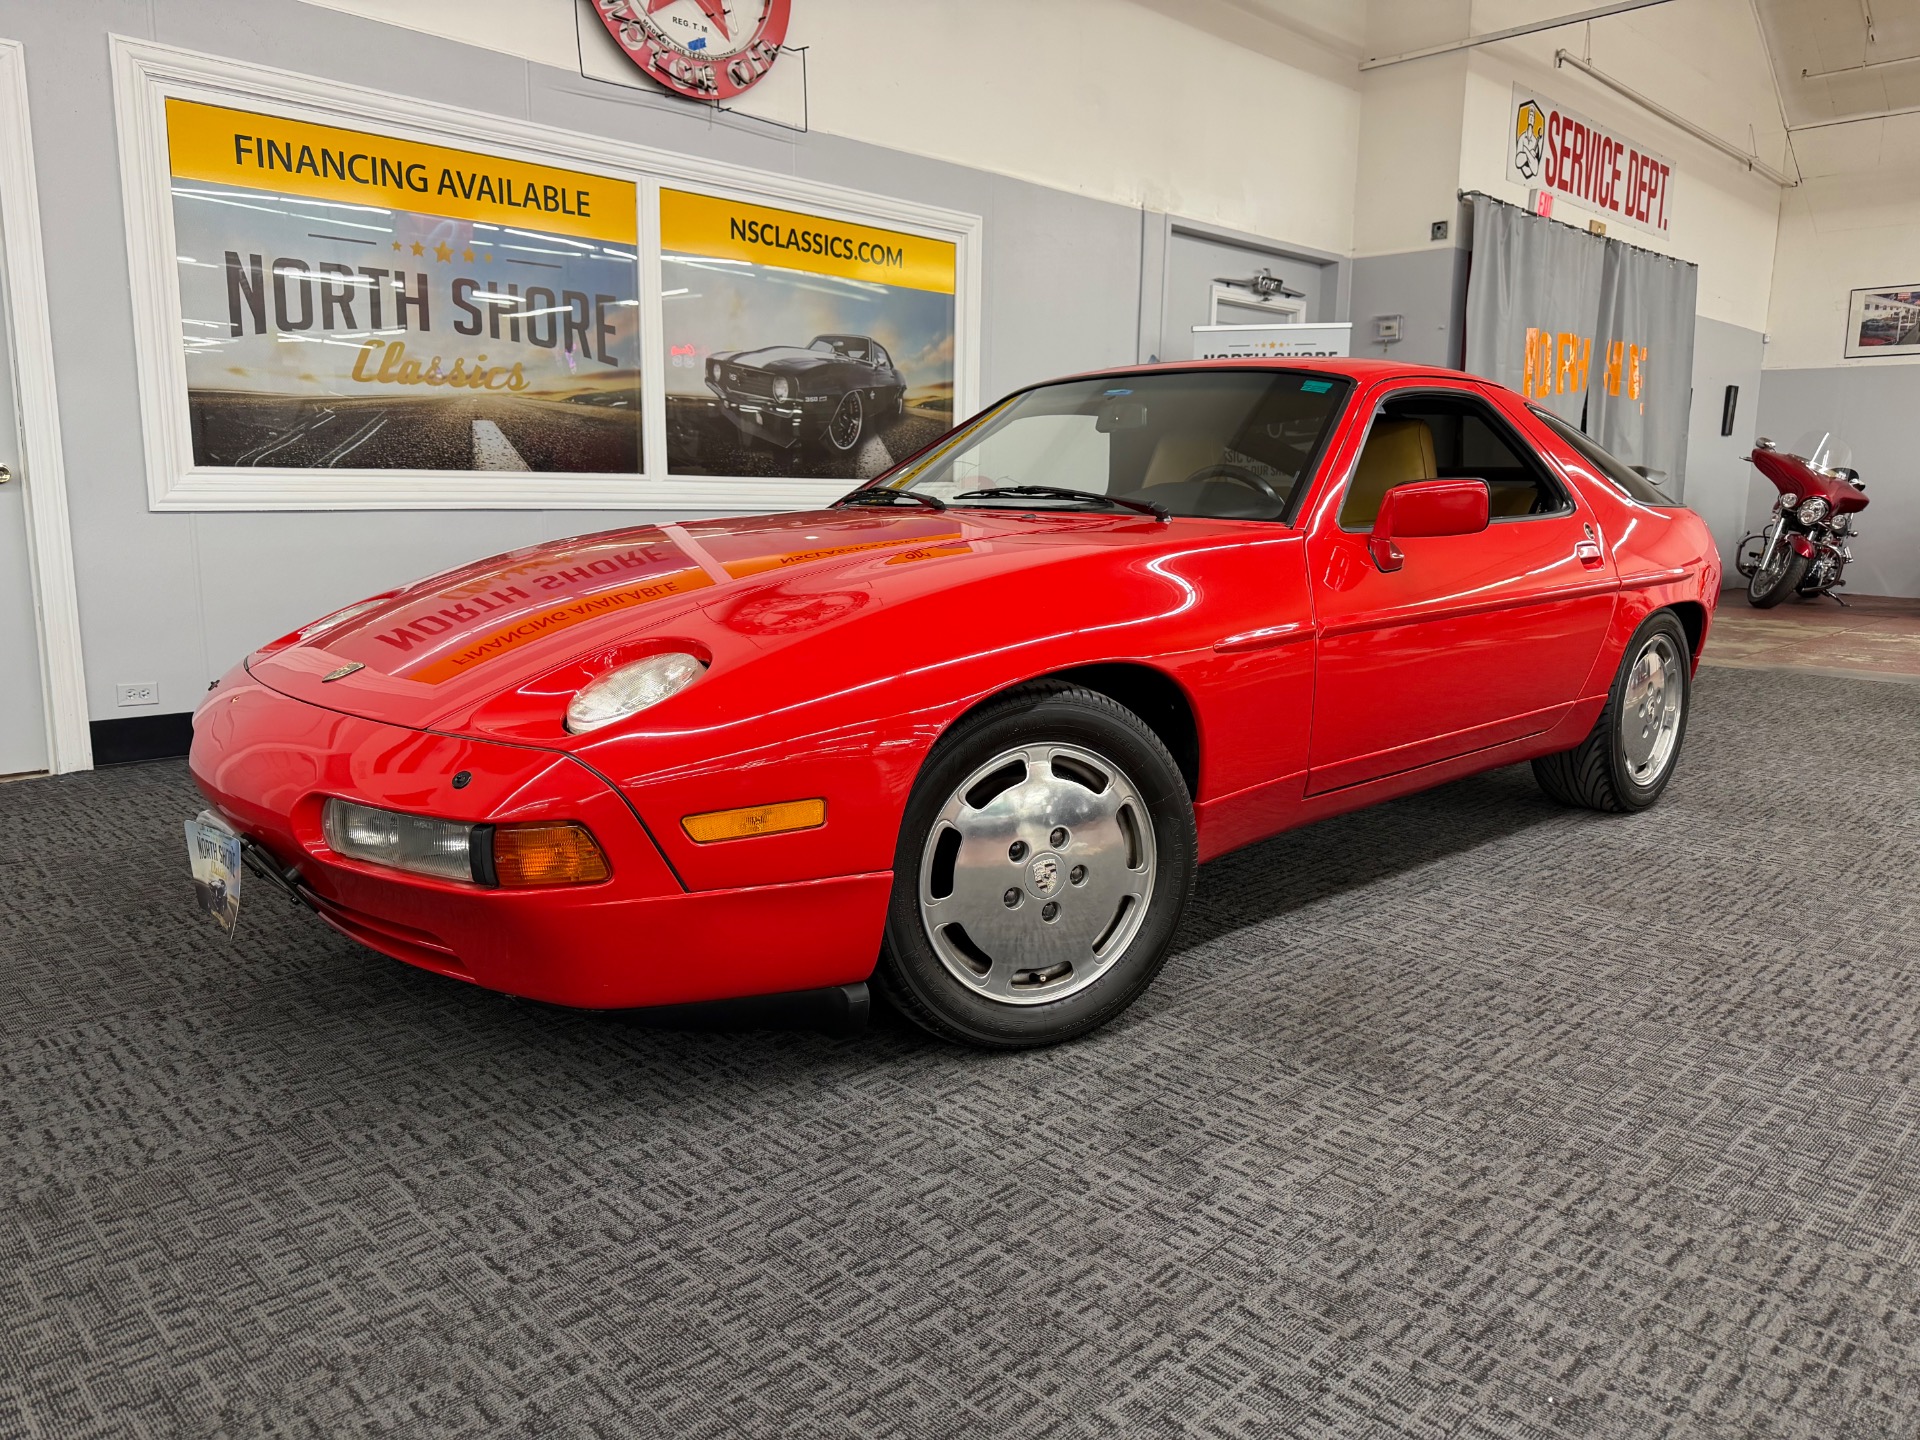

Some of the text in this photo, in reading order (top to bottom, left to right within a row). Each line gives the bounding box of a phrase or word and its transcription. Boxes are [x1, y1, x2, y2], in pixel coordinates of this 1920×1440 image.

[673, 45, 686, 55] THE
[234, 133, 592, 218] FINANCING AVAILABLE
[1545, 110, 1670, 231] SERVICE DEPT.
[730, 217, 903, 269] NSCLASSICS.COM
[224, 250, 619, 367] NORTH SHORE
[351, 339, 531, 393] Classics
